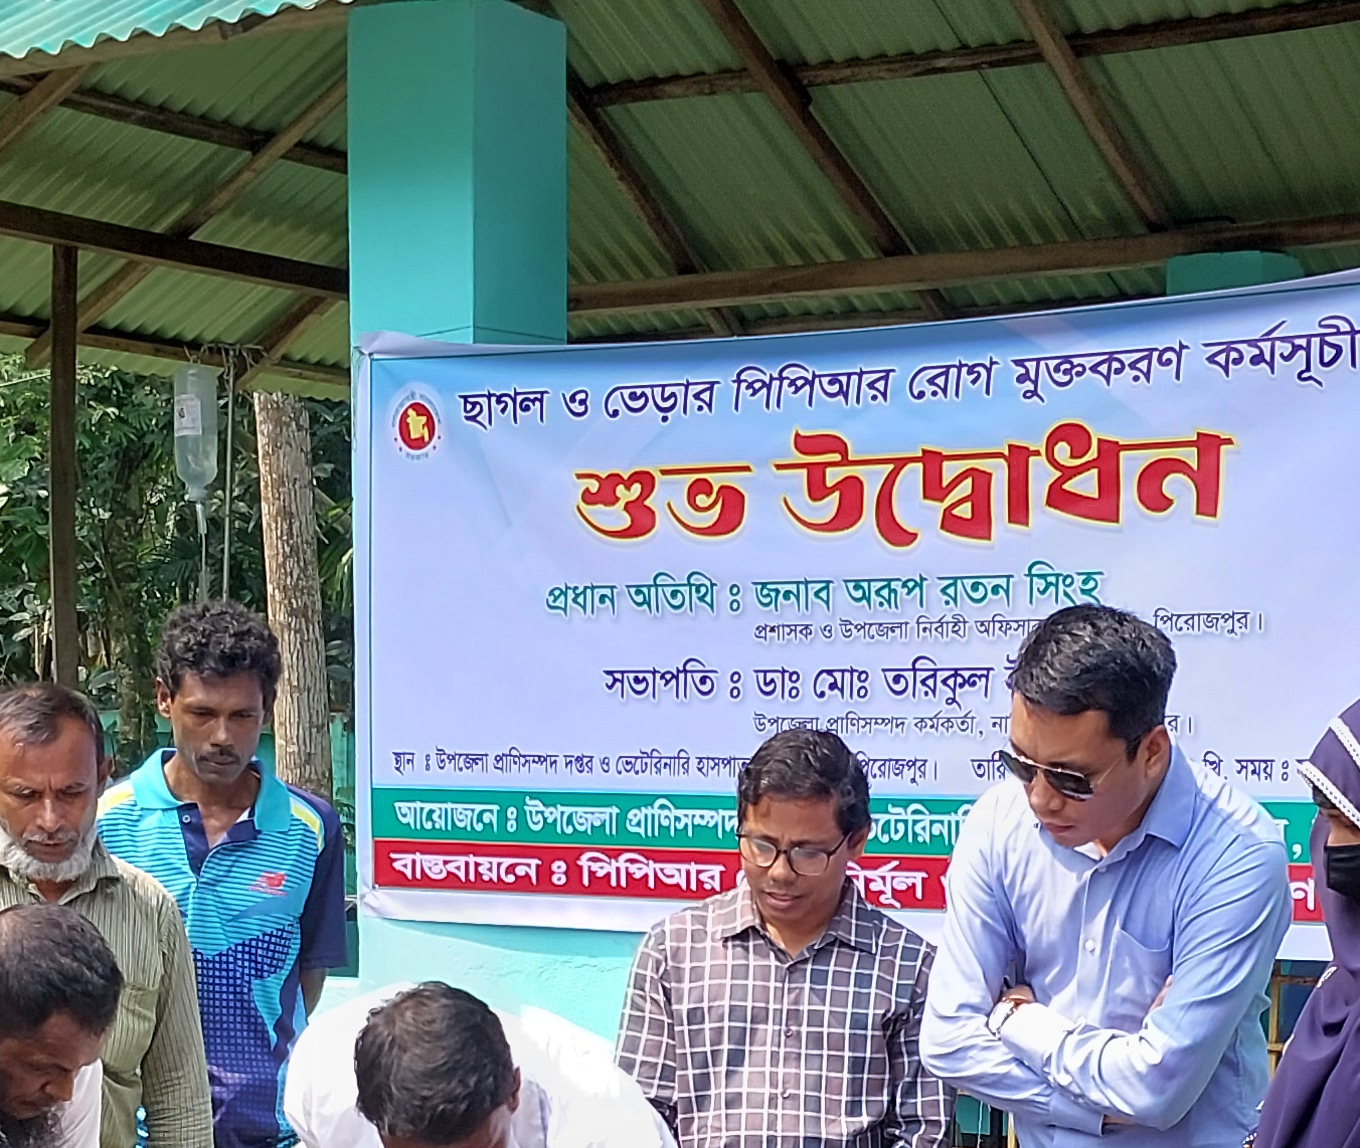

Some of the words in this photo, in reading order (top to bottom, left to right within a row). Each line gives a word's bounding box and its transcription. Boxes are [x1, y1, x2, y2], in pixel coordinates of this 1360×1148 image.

[458, 387, 549, 429] ছাগল
[562, 394, 590, 419] ও
[604, 378, 721, 424] ভেড়ার
[733, 363, 896, 412] পিপিআর
[907, 355, 1000, 401] রোগ
[1011, 340, 1190, 403] মুক্তকরণ
[574, 464, 753, 541] শুভ
[772, 420, 1236, 551] উদ্বোধন
[546, 582, 618, 618] প্রধান
[625, 571, 718, 615] অতিথি
[751, 576, 834, 612] জনাব
[842, 572, 929, 611] অরূপ
[937, 573, 1014, 608] রতন
[1023, 560, 1105, 607] সিংহ
[753, 620, 814, 642] প্রশাসক
[819, 622, 834, 641] ও
[839, 616, 910, 642] উপজেলা
[915, 612, 969, 641] নির্বাহী
[603, 657, 719, 700] সভাপতি
[752, 664, 801, 700] ডাঃ
[812, 664, 870, 700] মোঃ
[880, 655, 995, 709] তরিকুল
[753, 711, 820, 735] উপজেলা
[826, 710, 908, 735] প্রাণিসম্পদ
[391, 749, 416, 777] স্থান
[435, 746, 489, 774] উপজেলা
[492, 746, 560, 777] প্রাণিসম্পদ
[563, 752, 595, 777] দপ্তর
[599, 755, 611, 774] ও
[616, 748, 691, 778] ভেটেরিনারি
[970, 750, 1007, 781] তারি
[1234, 758, 1276, 782] সময়
[393, 800, 500, 833] আয়োজনে
[524, 796, 621, 838] উপজেলা
[389, 851, 541, 886] বাস্তবায়নে
[576, 851, 727, 893] পিপিআর
